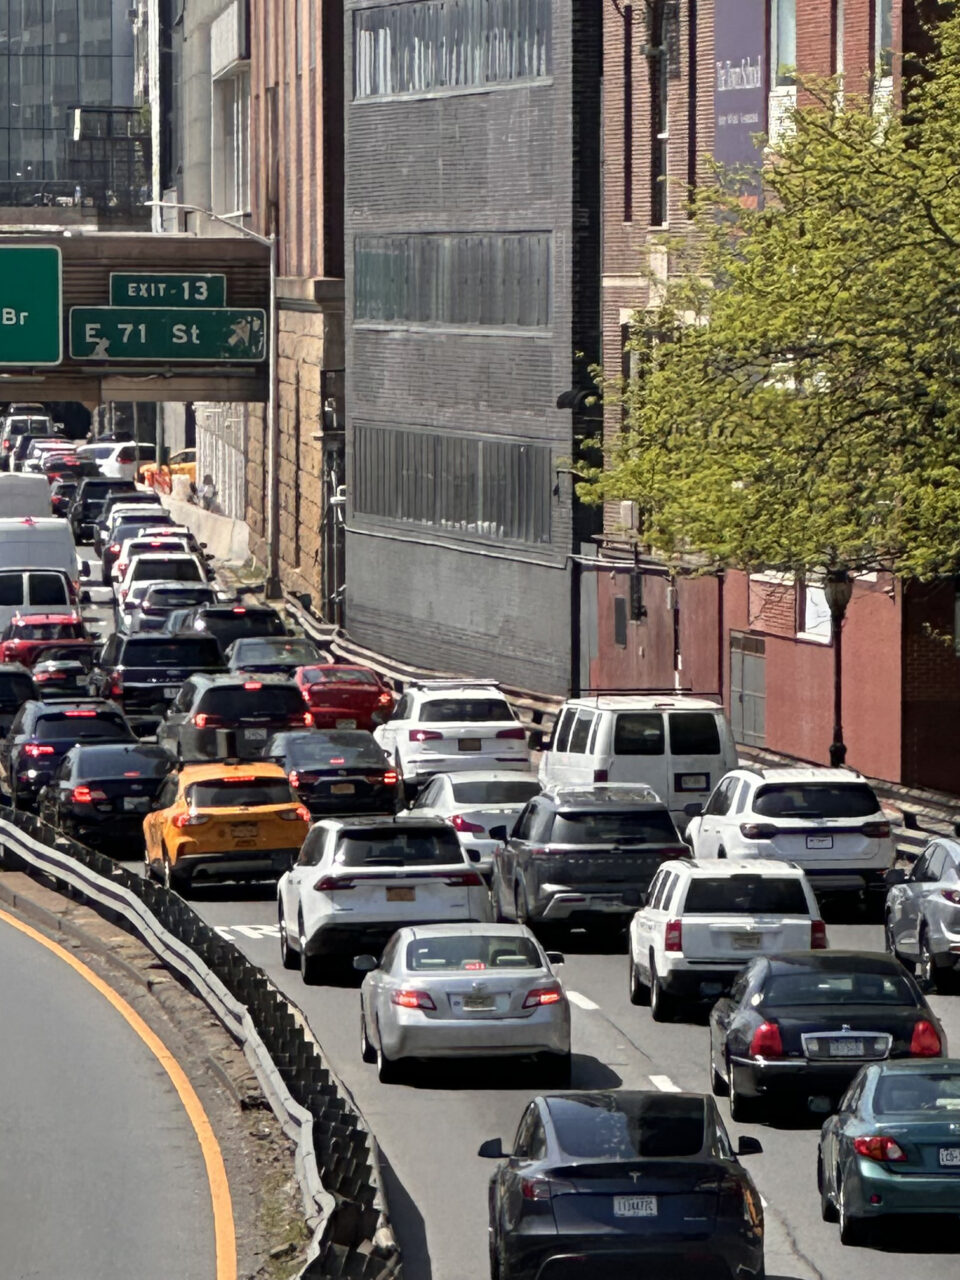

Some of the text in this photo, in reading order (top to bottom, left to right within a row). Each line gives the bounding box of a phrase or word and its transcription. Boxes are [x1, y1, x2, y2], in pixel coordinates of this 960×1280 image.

[127, 281, 208, 300] EXIT 13
[2, 308, 28, 325] Br
[85, 323, 200, 344] E 71 St
